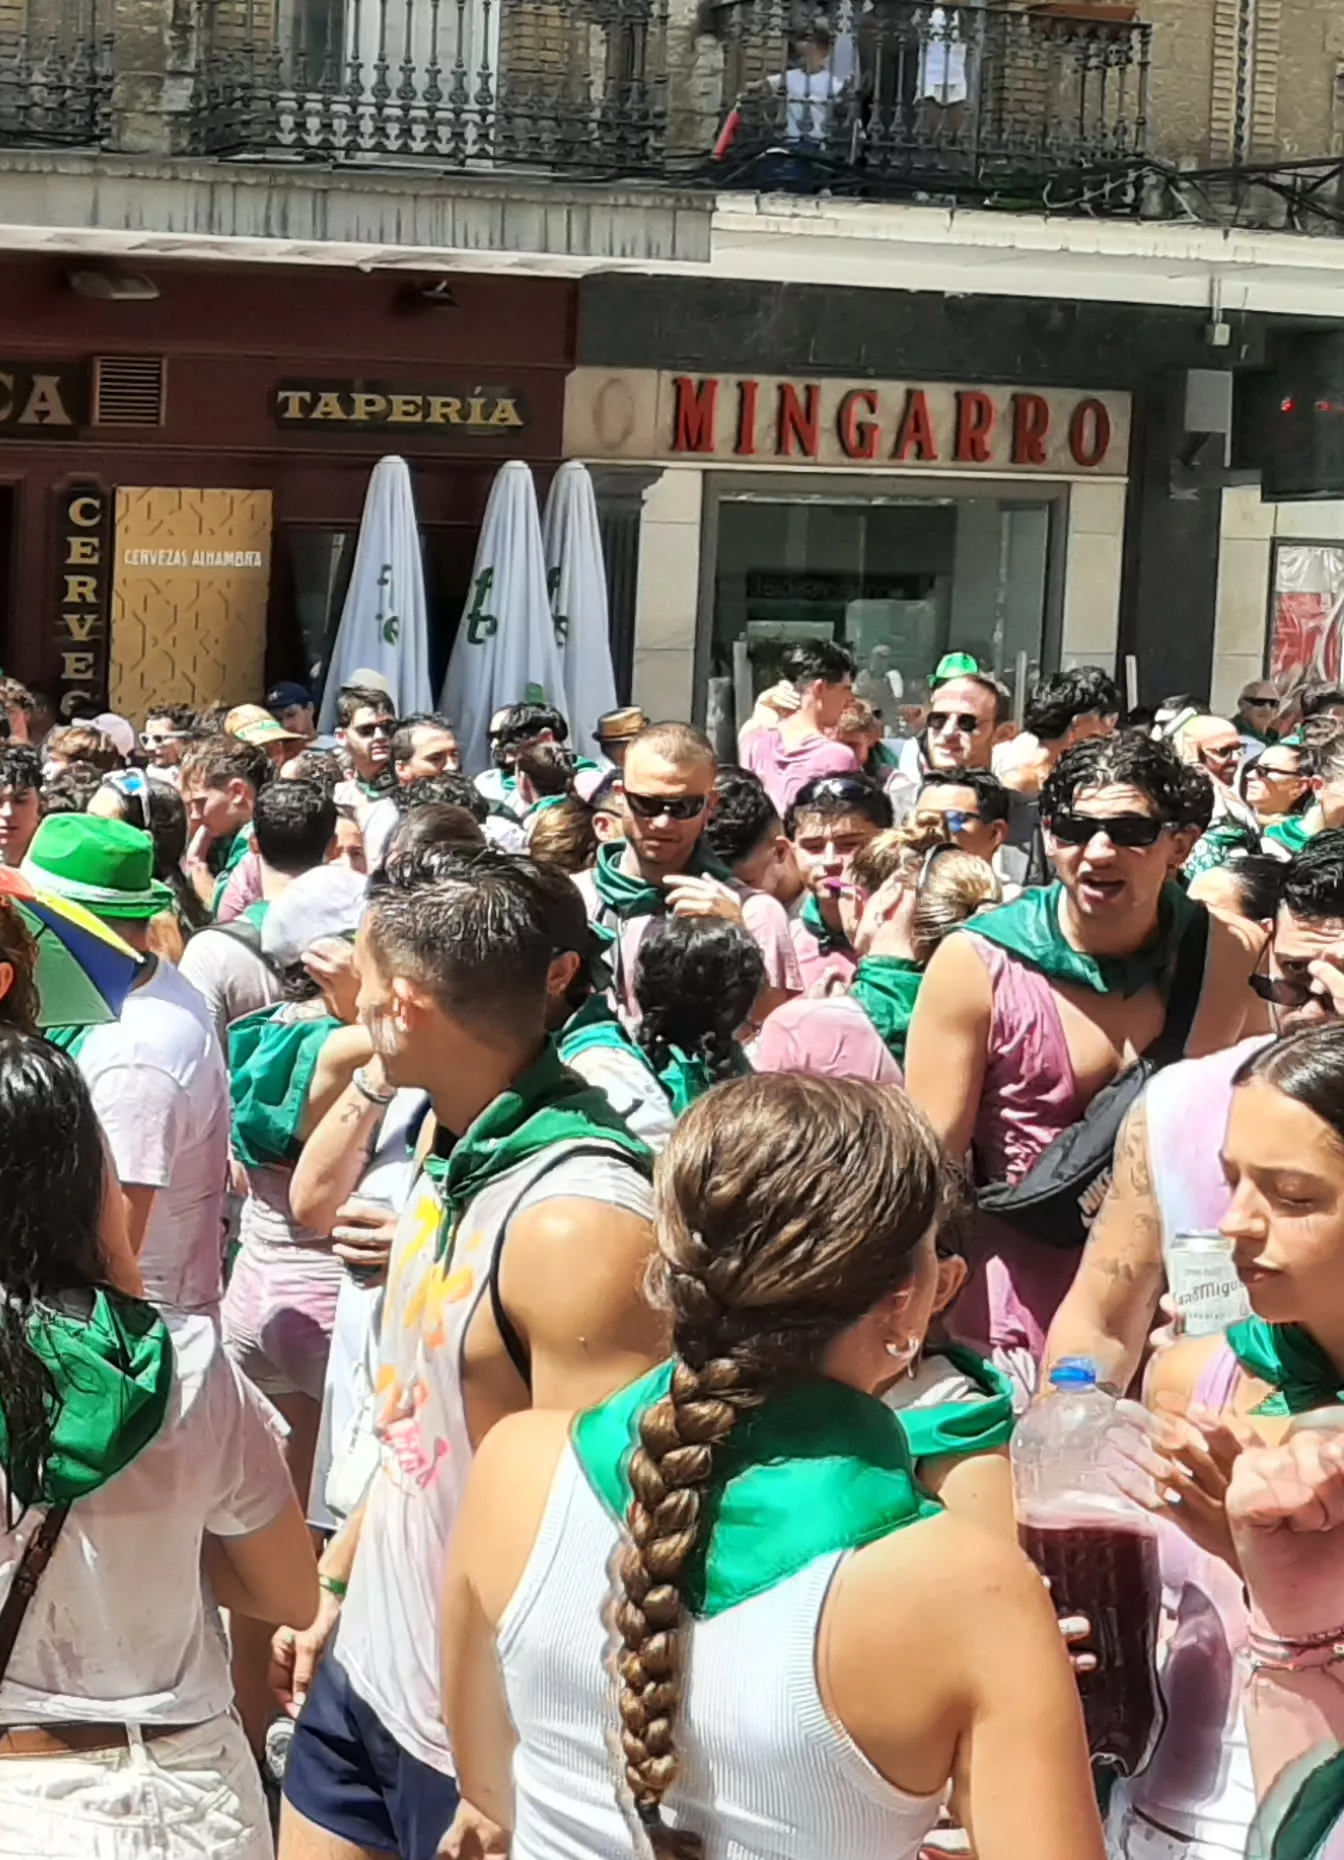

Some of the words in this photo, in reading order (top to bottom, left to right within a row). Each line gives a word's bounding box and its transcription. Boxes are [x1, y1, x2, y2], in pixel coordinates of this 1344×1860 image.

[276, 386, 525, 426] TAPERÍA
[671, 376, 1111, 468] MINGARRO
[124, 549, 187, 567] CERVEZAS
[192, 550, 262, 568] ALHAMBRA
